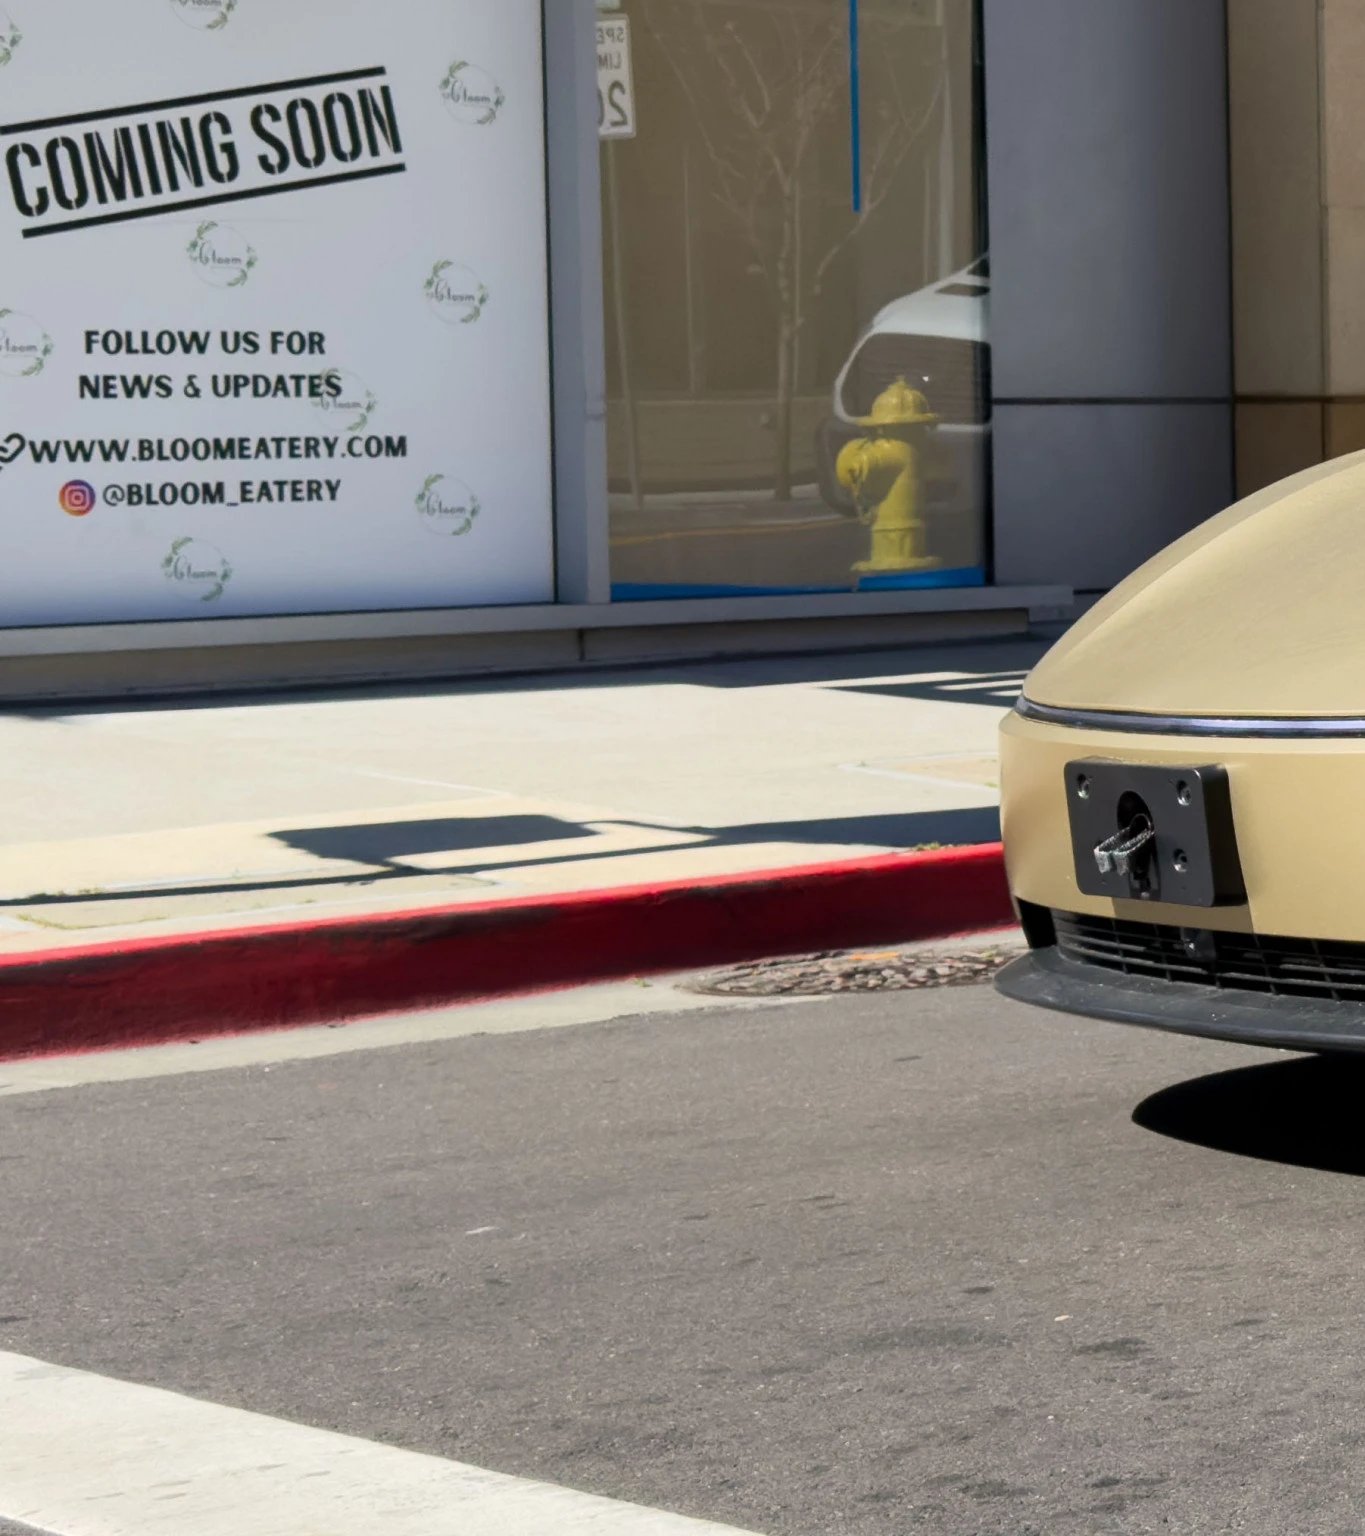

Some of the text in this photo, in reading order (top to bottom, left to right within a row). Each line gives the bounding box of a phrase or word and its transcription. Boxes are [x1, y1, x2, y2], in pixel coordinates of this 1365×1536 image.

[5, 85, 402, 218] COMING SOON
[84, 330, 326, 355] FOLLOW US FOR
[79, 374, 342, 399] NEWS & UPDATES
[29, 436, 407, 463] WWW.BLOOMEATERY.COM
[103, 479, 341, 506] @BLOOM_EATERY
